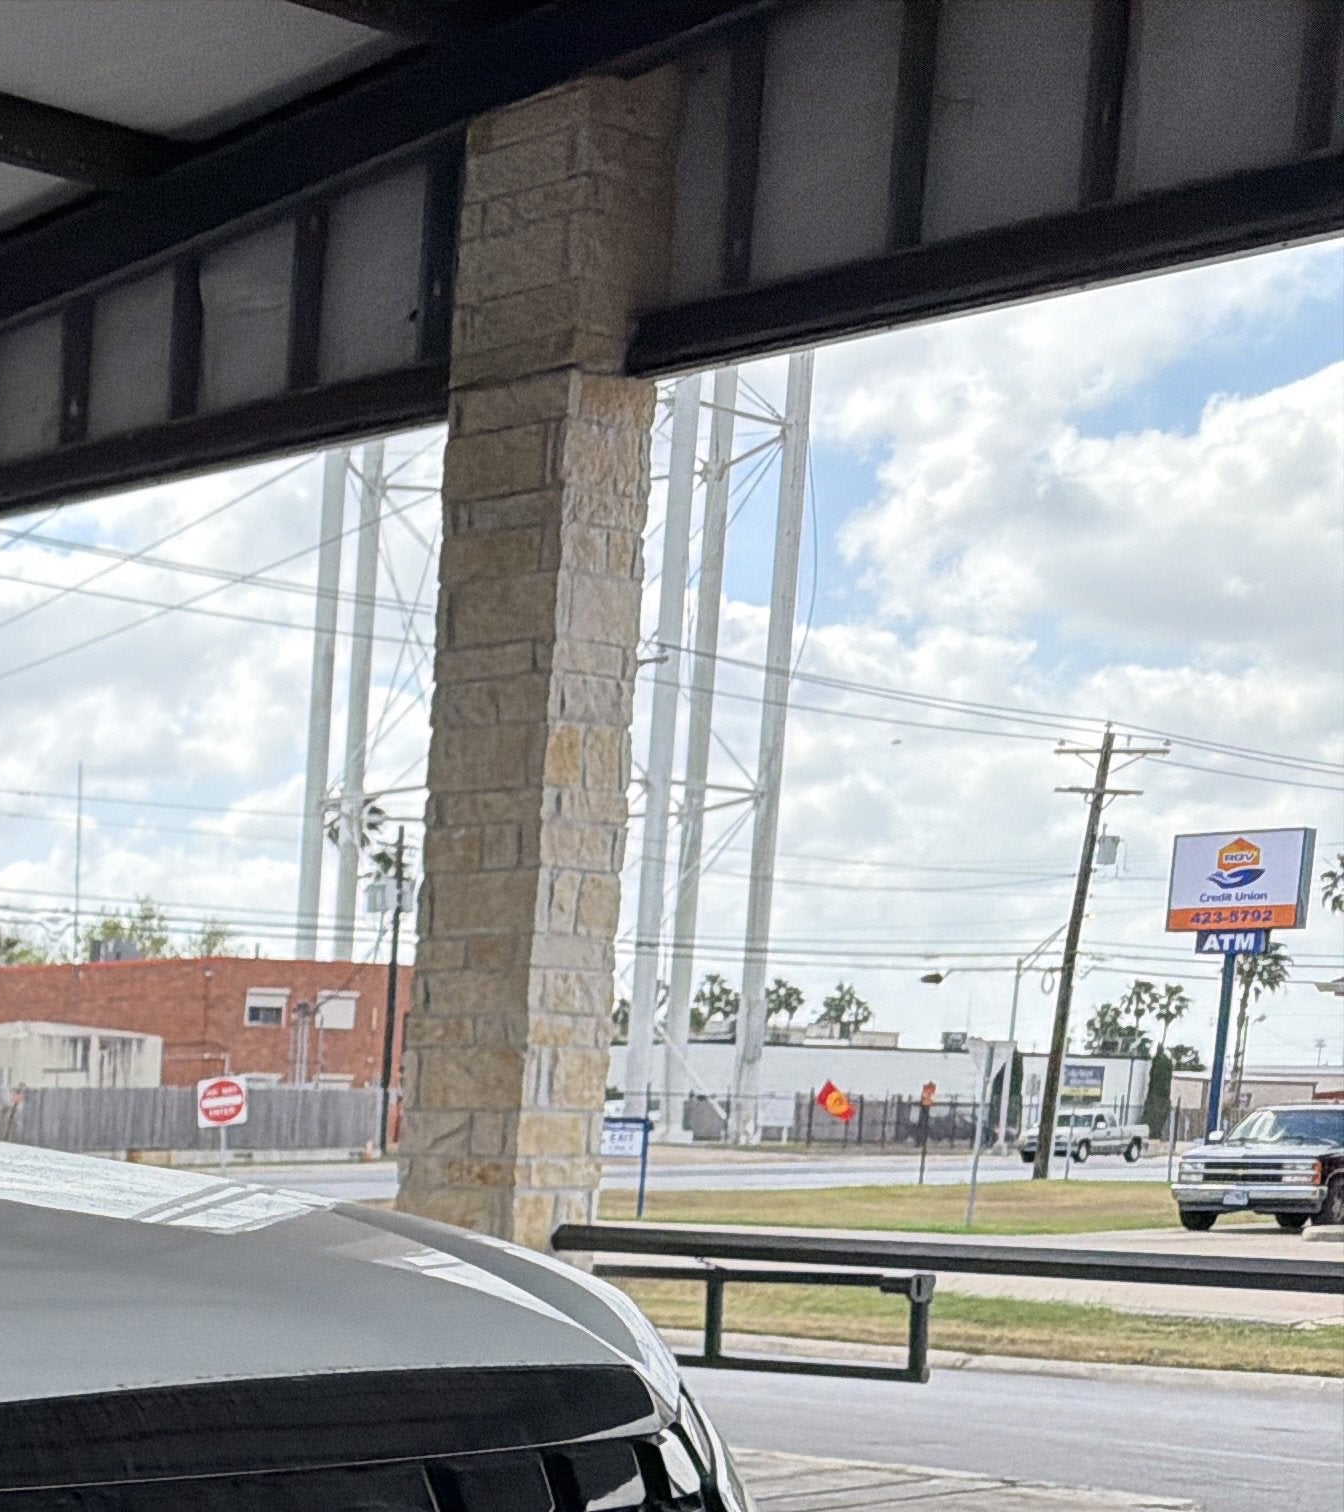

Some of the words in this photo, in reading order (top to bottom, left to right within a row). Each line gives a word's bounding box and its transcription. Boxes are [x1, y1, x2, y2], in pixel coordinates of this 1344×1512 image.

[1199, 893, 1232, 902] Credit
[1235, 891, 1268, 901] Union
[1202, 933, 1255, 951] ATM
